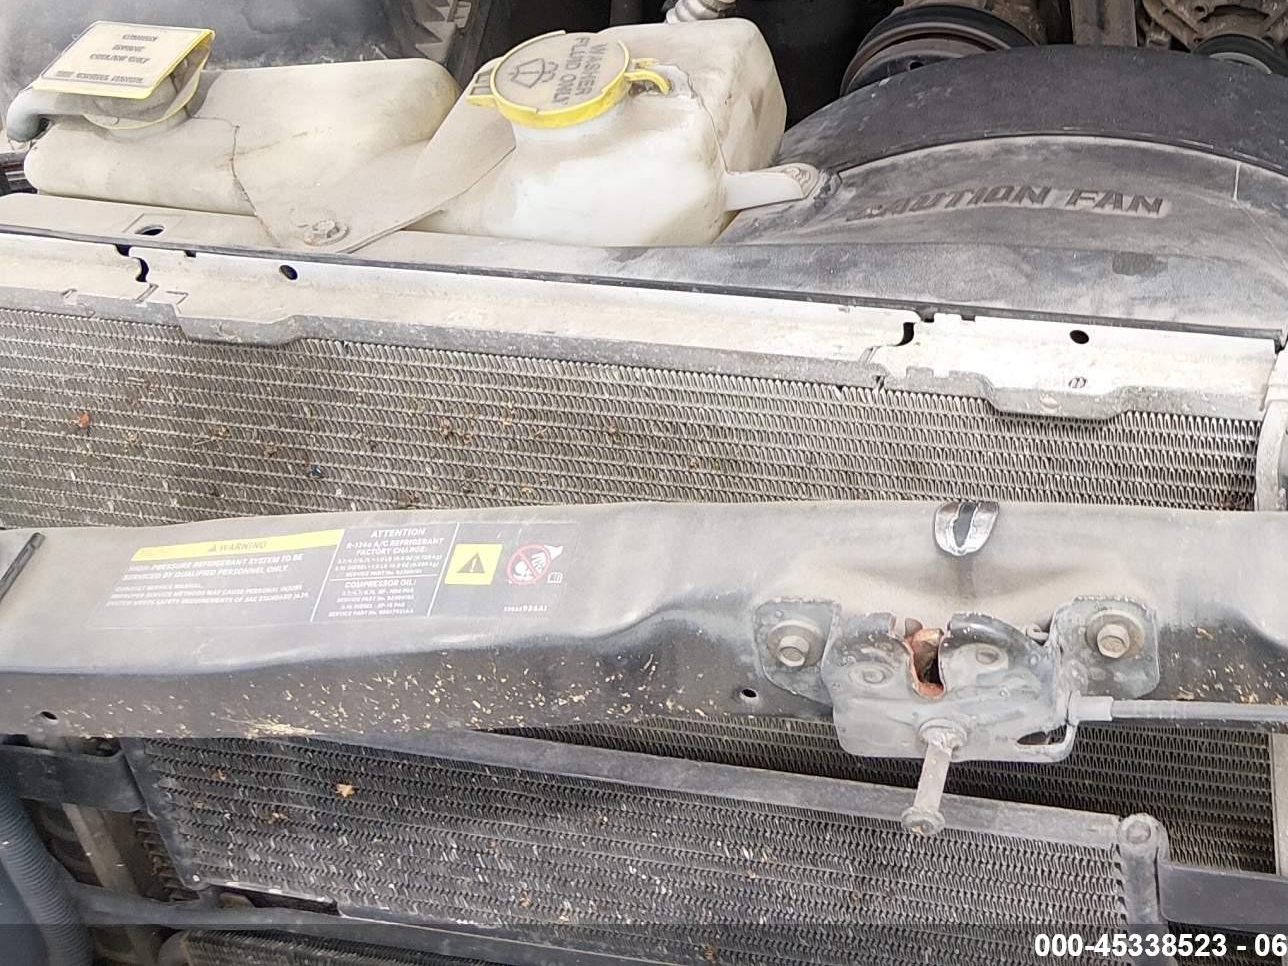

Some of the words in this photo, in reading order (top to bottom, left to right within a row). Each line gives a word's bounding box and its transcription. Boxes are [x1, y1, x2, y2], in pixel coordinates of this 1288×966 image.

[565, 36, 591, 71] FLUID
[574, 42, 609, 96] WASHER
[551, 73, 577, 105] ONLY
[1064, 187, 1164, 215] FAN
[370, 528, 427, 539] ATTENTION
[219, 540, 268, 553] WARNING
[373, 539, 389, 548] A/C
[390, 537, 445, 547] REFRIGERANT
[356, 546, 392, 556] FACTORY
[192, 558, 249, 569] REFRIGERANT
[249, 555, 281, 565] SYSTEM
[281, 554, 292, 563] TO
[293, 553, 304, 562] BE
[174, 569, 217, 579] QUALIFIED
[217, 566, 265, 576] PERSONNEL
[344, 579, 399, 588] COMPRESSOR
